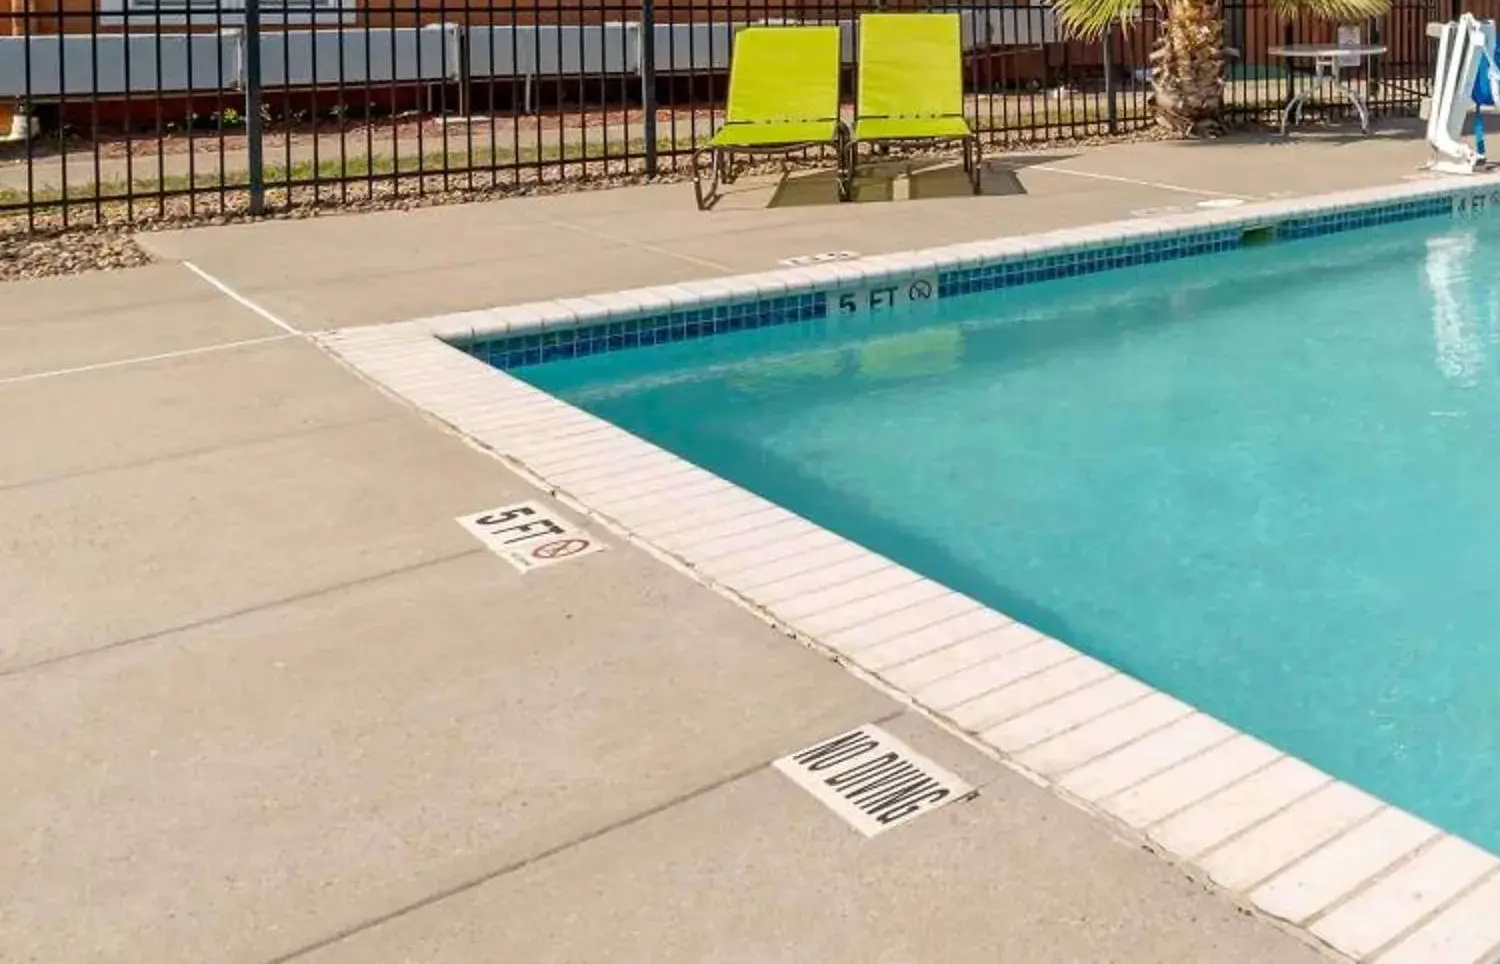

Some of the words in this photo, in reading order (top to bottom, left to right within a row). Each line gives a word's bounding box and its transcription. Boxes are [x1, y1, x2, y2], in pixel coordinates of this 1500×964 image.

[838, 292, 857, 314] 5
[869, 285, 899, 311] FT
[792, 730, 881, 772] NO
[823, 751, 951, 826] DIVING
